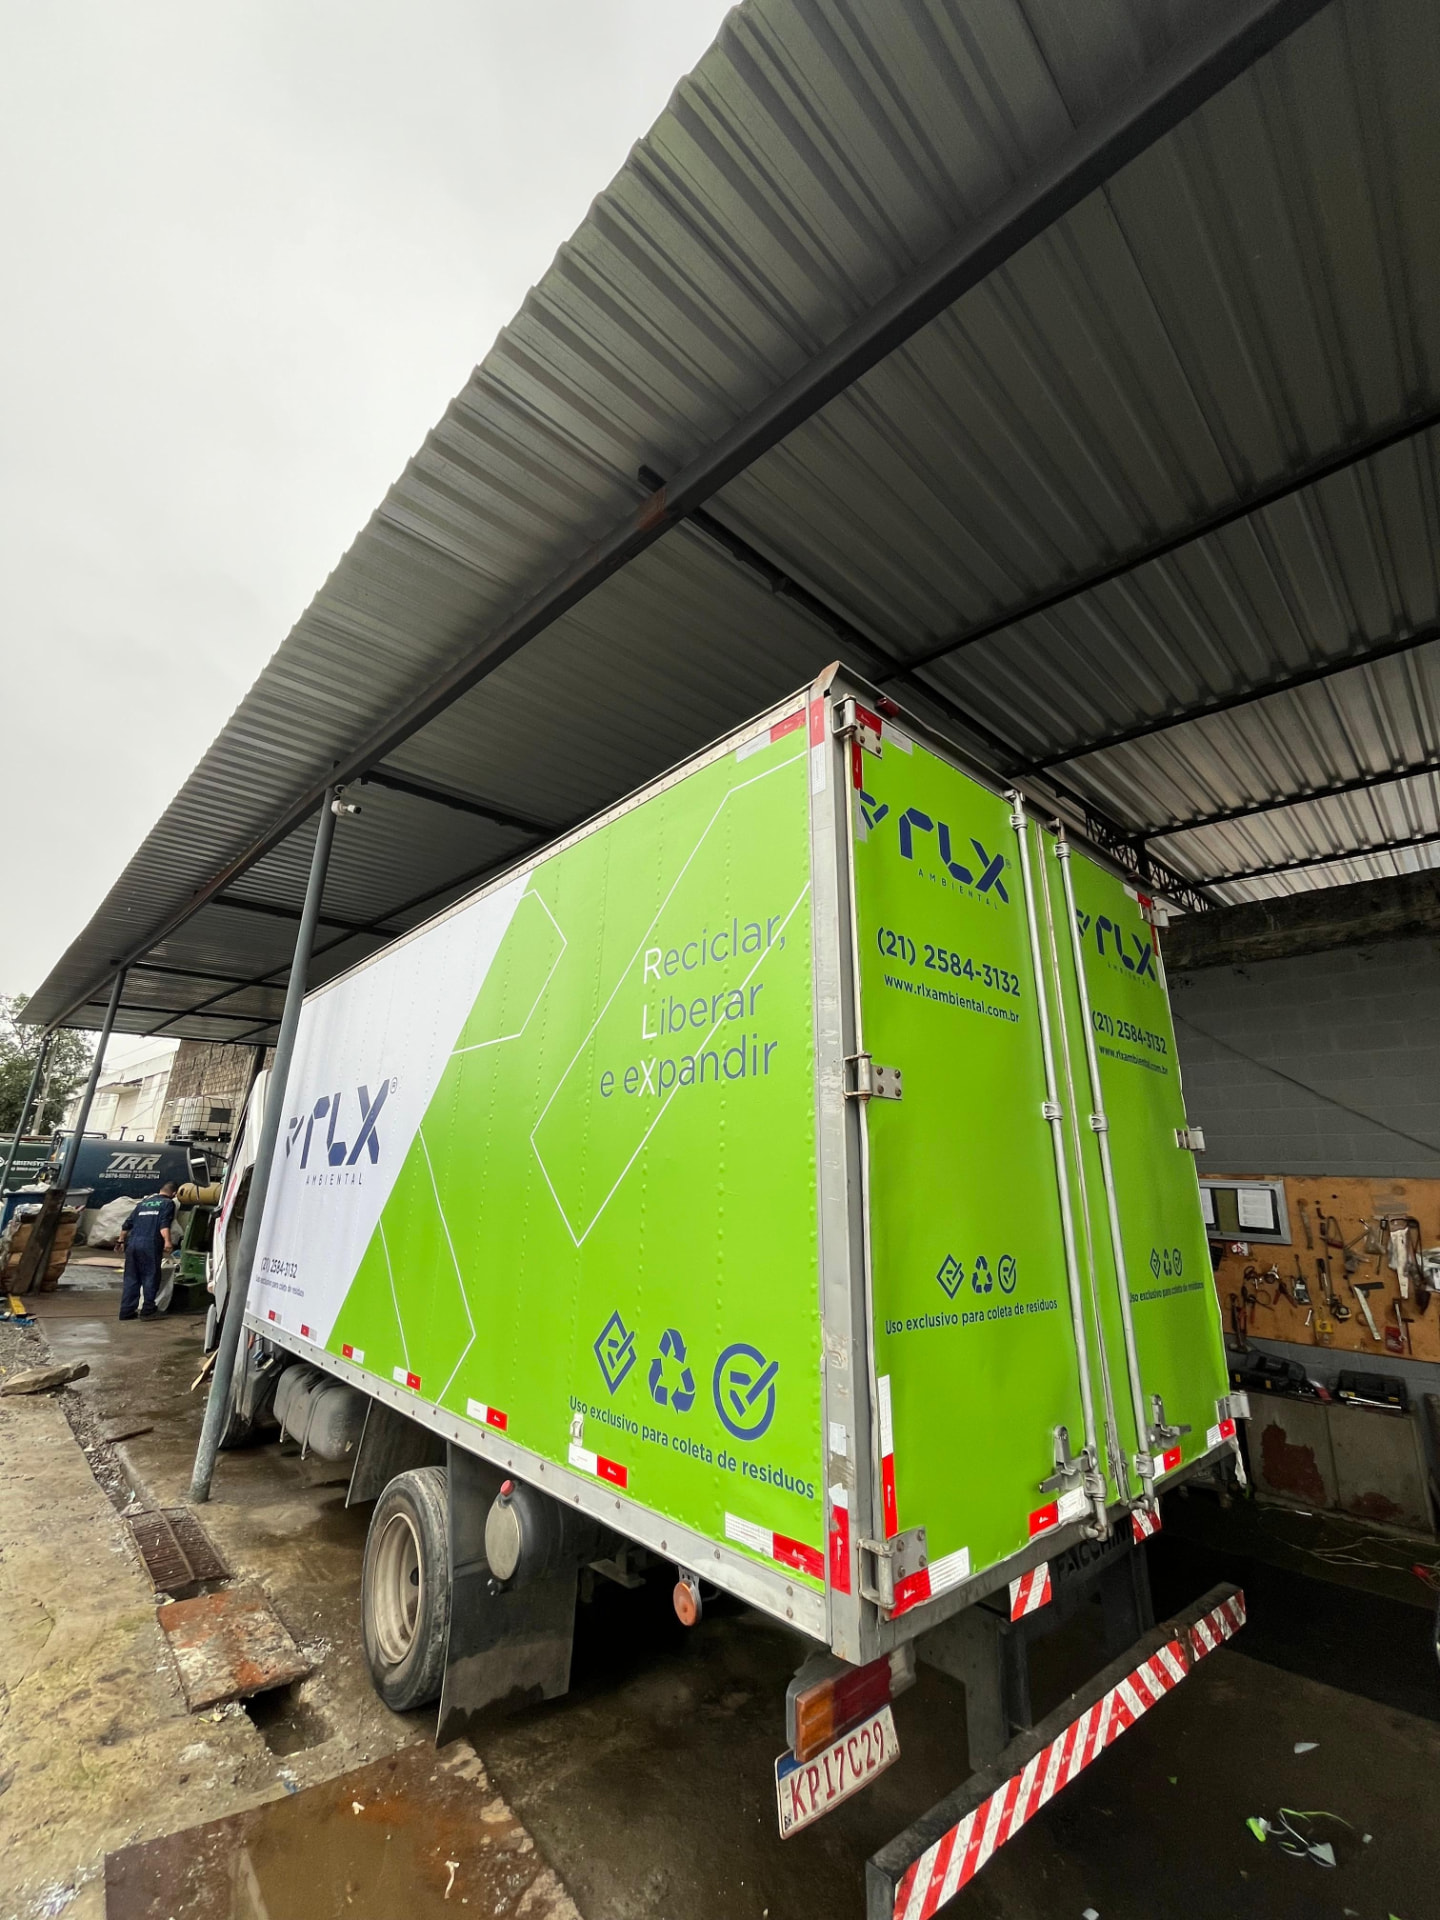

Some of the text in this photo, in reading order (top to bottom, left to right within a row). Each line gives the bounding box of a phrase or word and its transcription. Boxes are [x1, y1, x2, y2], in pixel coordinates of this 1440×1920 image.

[918, 868, 998, 910] AMBIENTAL
[643, 914, 786, 985] Reciclar,
[877, 926, 1021, 997] (21) 2584-3132
[642, 983, 764, 1040] Liberar
[884, 974, 1020, 1024] www.rlxambiental.com.br
[1092, 1010, 1168, 1055] (21) 2584-3132
[600, 1033, 778, 1098] e eXpandir
[107, 1152, 162, 1170] TRR
[306, 1173, 363, 1186] AMBIENTAL
[885, 1319, 903, 1335] Uso
[906, 1312, 959, 1331] exclusivo
[961, 1309, 985, 1327] para
[987, 1305, 1012, 1320] coleta
[1015, 1302, 1024, 1316] de
[569, 1395, 815, 1500] Uso exclusivo para coleta de residuos
[789, 1719, 885, 1822] KPI7C29
